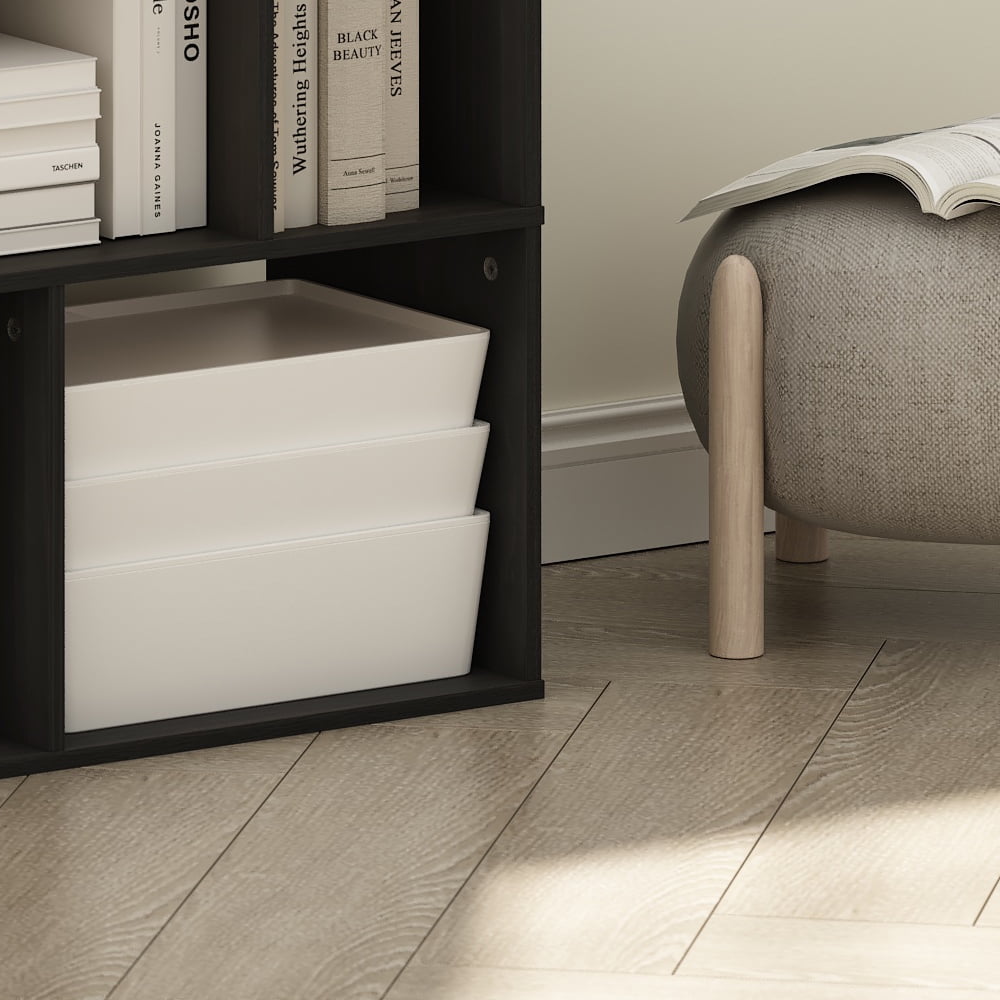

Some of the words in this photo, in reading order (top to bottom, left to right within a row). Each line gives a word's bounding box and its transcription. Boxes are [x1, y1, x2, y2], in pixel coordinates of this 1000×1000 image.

[292, 3, 309, 74] Heights
[333, 44, 382, 61] BEAUTY
[337, 29, 378, 45] BLACK
[389, 31, 402, 97] JEEVES
[292, 79, 309, 175] Wuthering
[51, 161, 84, 173] TASCHEN
